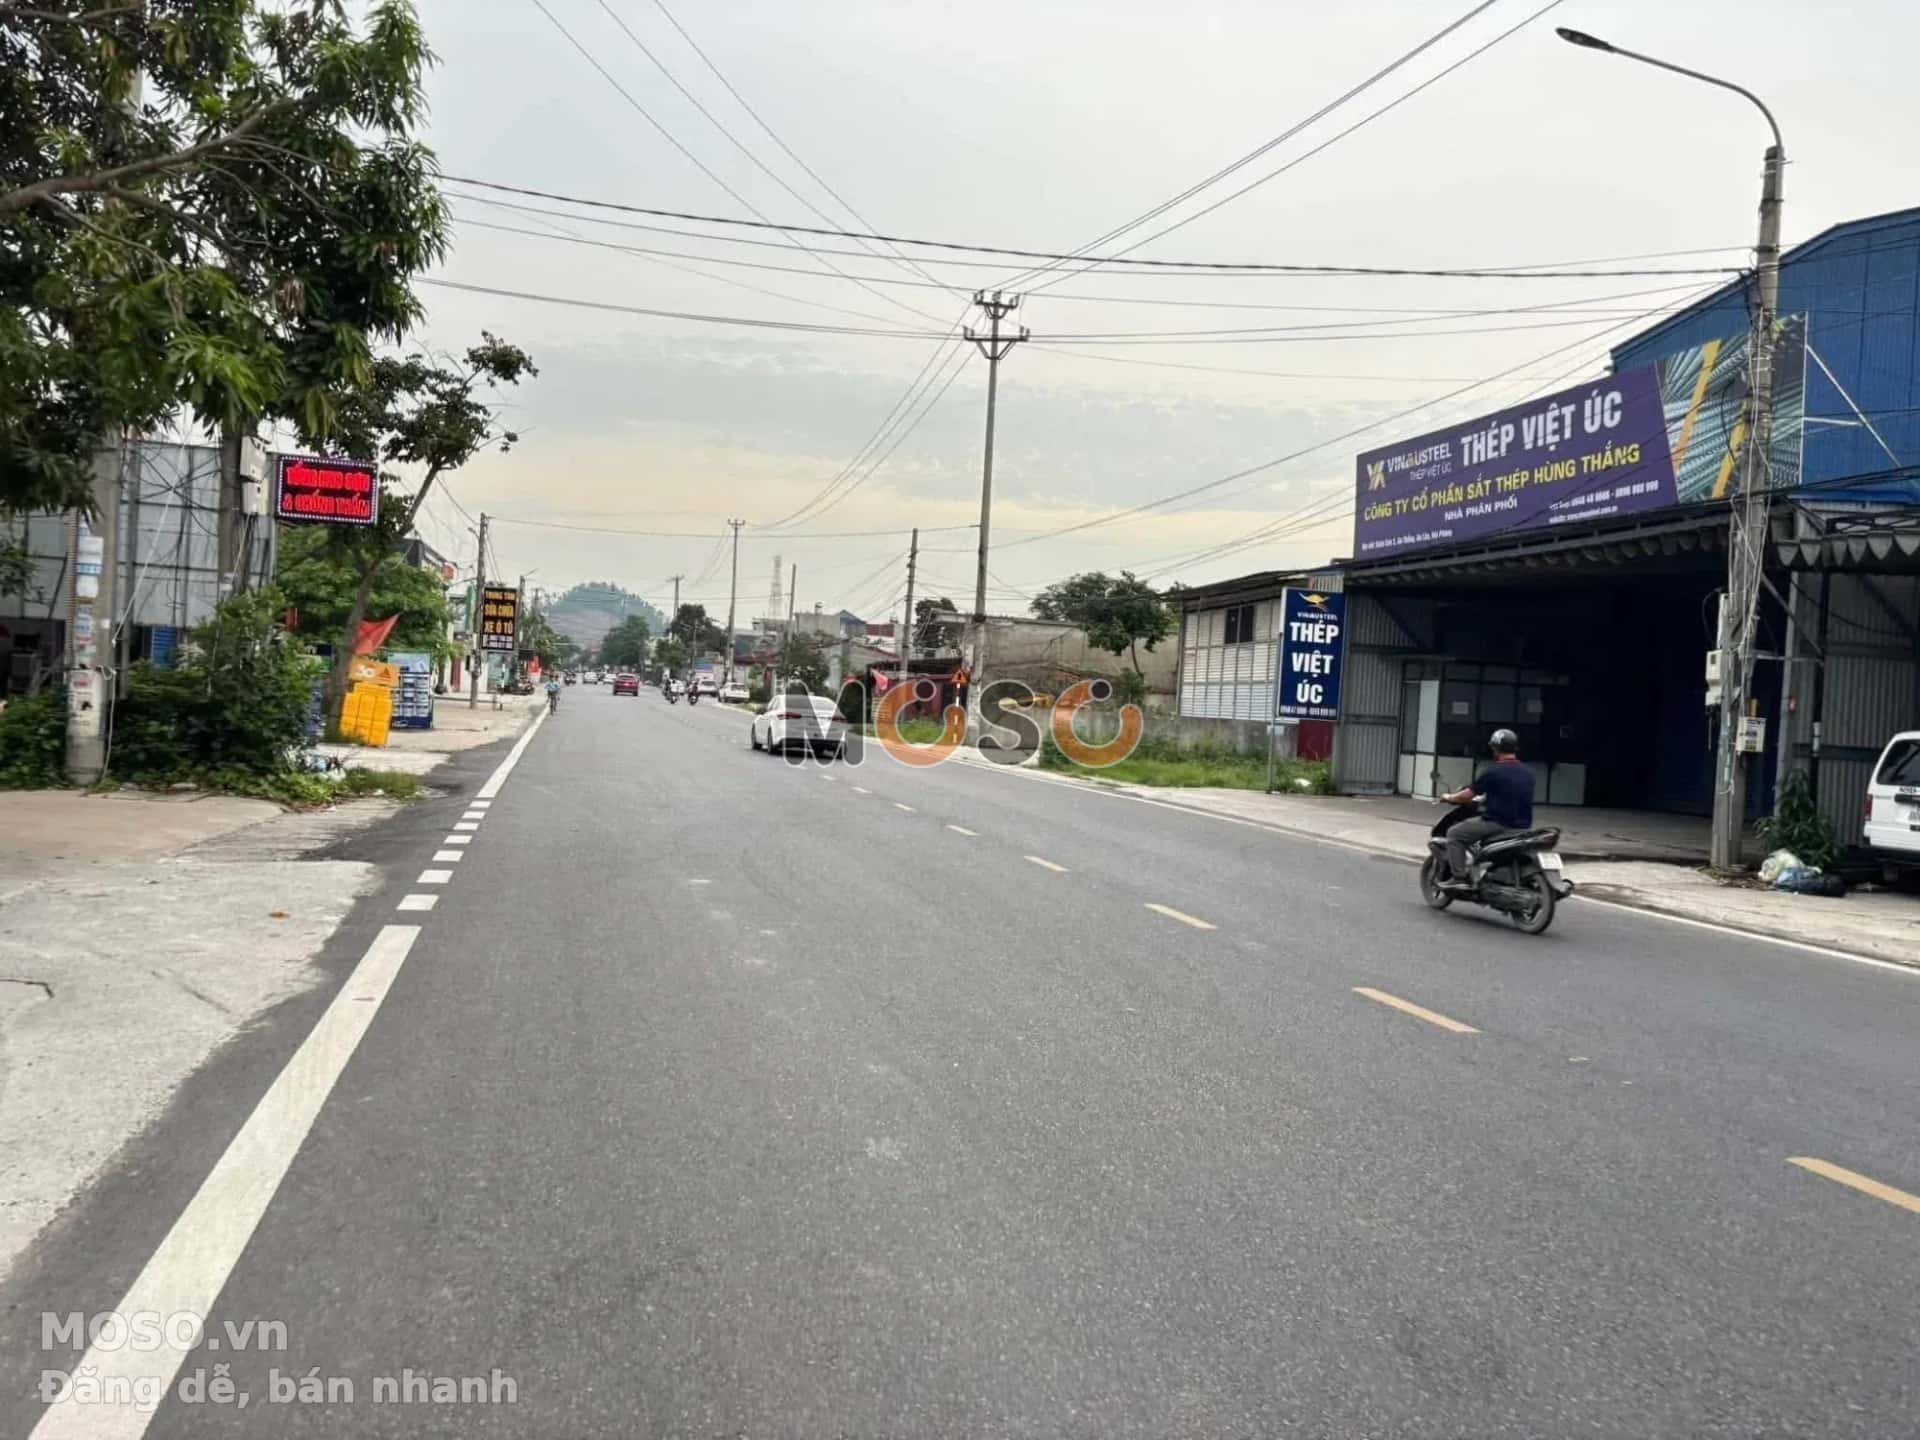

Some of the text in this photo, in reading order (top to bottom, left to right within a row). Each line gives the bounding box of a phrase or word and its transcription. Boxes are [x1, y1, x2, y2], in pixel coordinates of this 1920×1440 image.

[1460, 390, 1623, 467] THÉP VIỆT ÚC
[1364, 502, 1392, 521] CÔNG
[1395, 498, 1409, 514] TY
[1412, 486, 1428, 511] CỔ
[1495, 468, 1529, 493] THÉP
[1533, 459, 1576, 485] HÙNG
[1581, 440, 1640, 474] THẮNG
[1444, 507, 1463, 521] NHÀ
[1494, 494, 1518, 512] PHỐI
[1289, 619, 1340, 645] THÉP
[1291, 650, 1335, 678] VIỆT
[1296, 679, 1324, 704] ÚC
